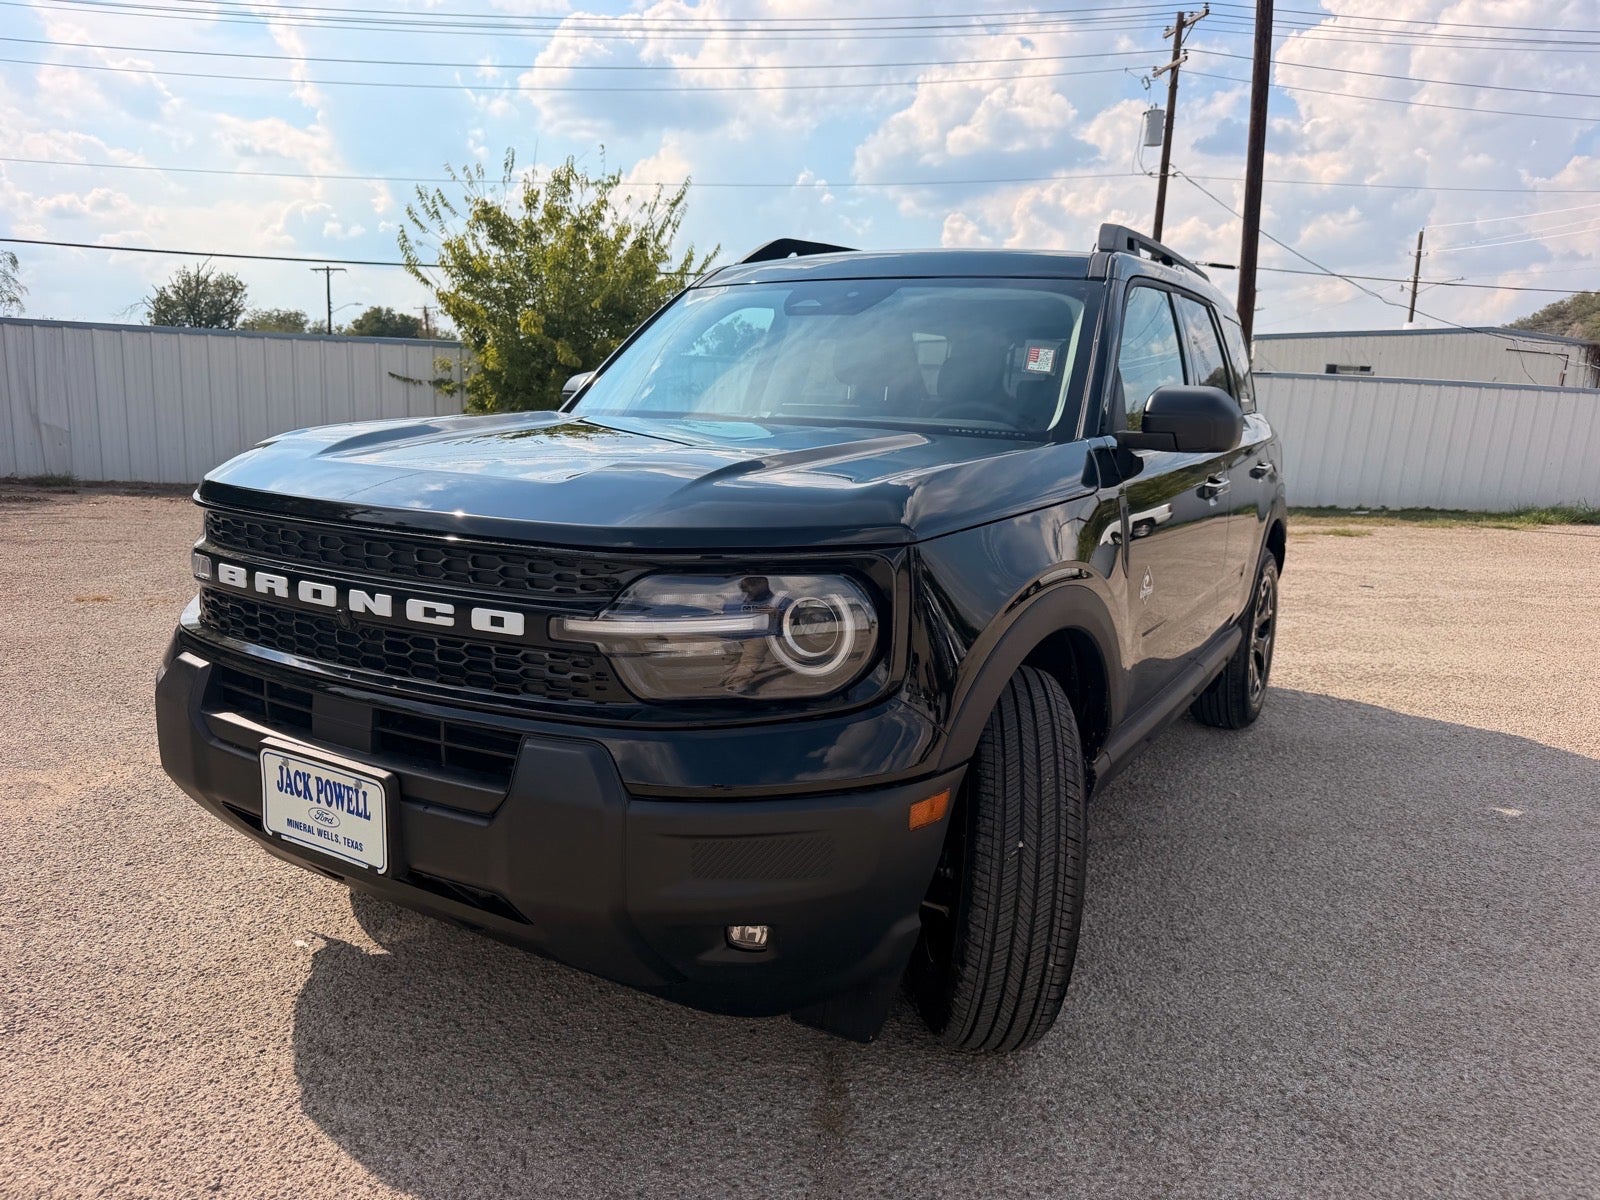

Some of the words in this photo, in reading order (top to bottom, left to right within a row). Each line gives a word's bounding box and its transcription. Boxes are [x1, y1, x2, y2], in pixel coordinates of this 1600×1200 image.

[218, 563, 525, 636] BRONCO
[277, 765, 313, 802] JACK
[315, 776, 371, 821] POWELL
[286, 817, 315, 836] MINERAL
[342, 836, 364, 852] TEXAS
[314, 809, 335, 825] Ford
